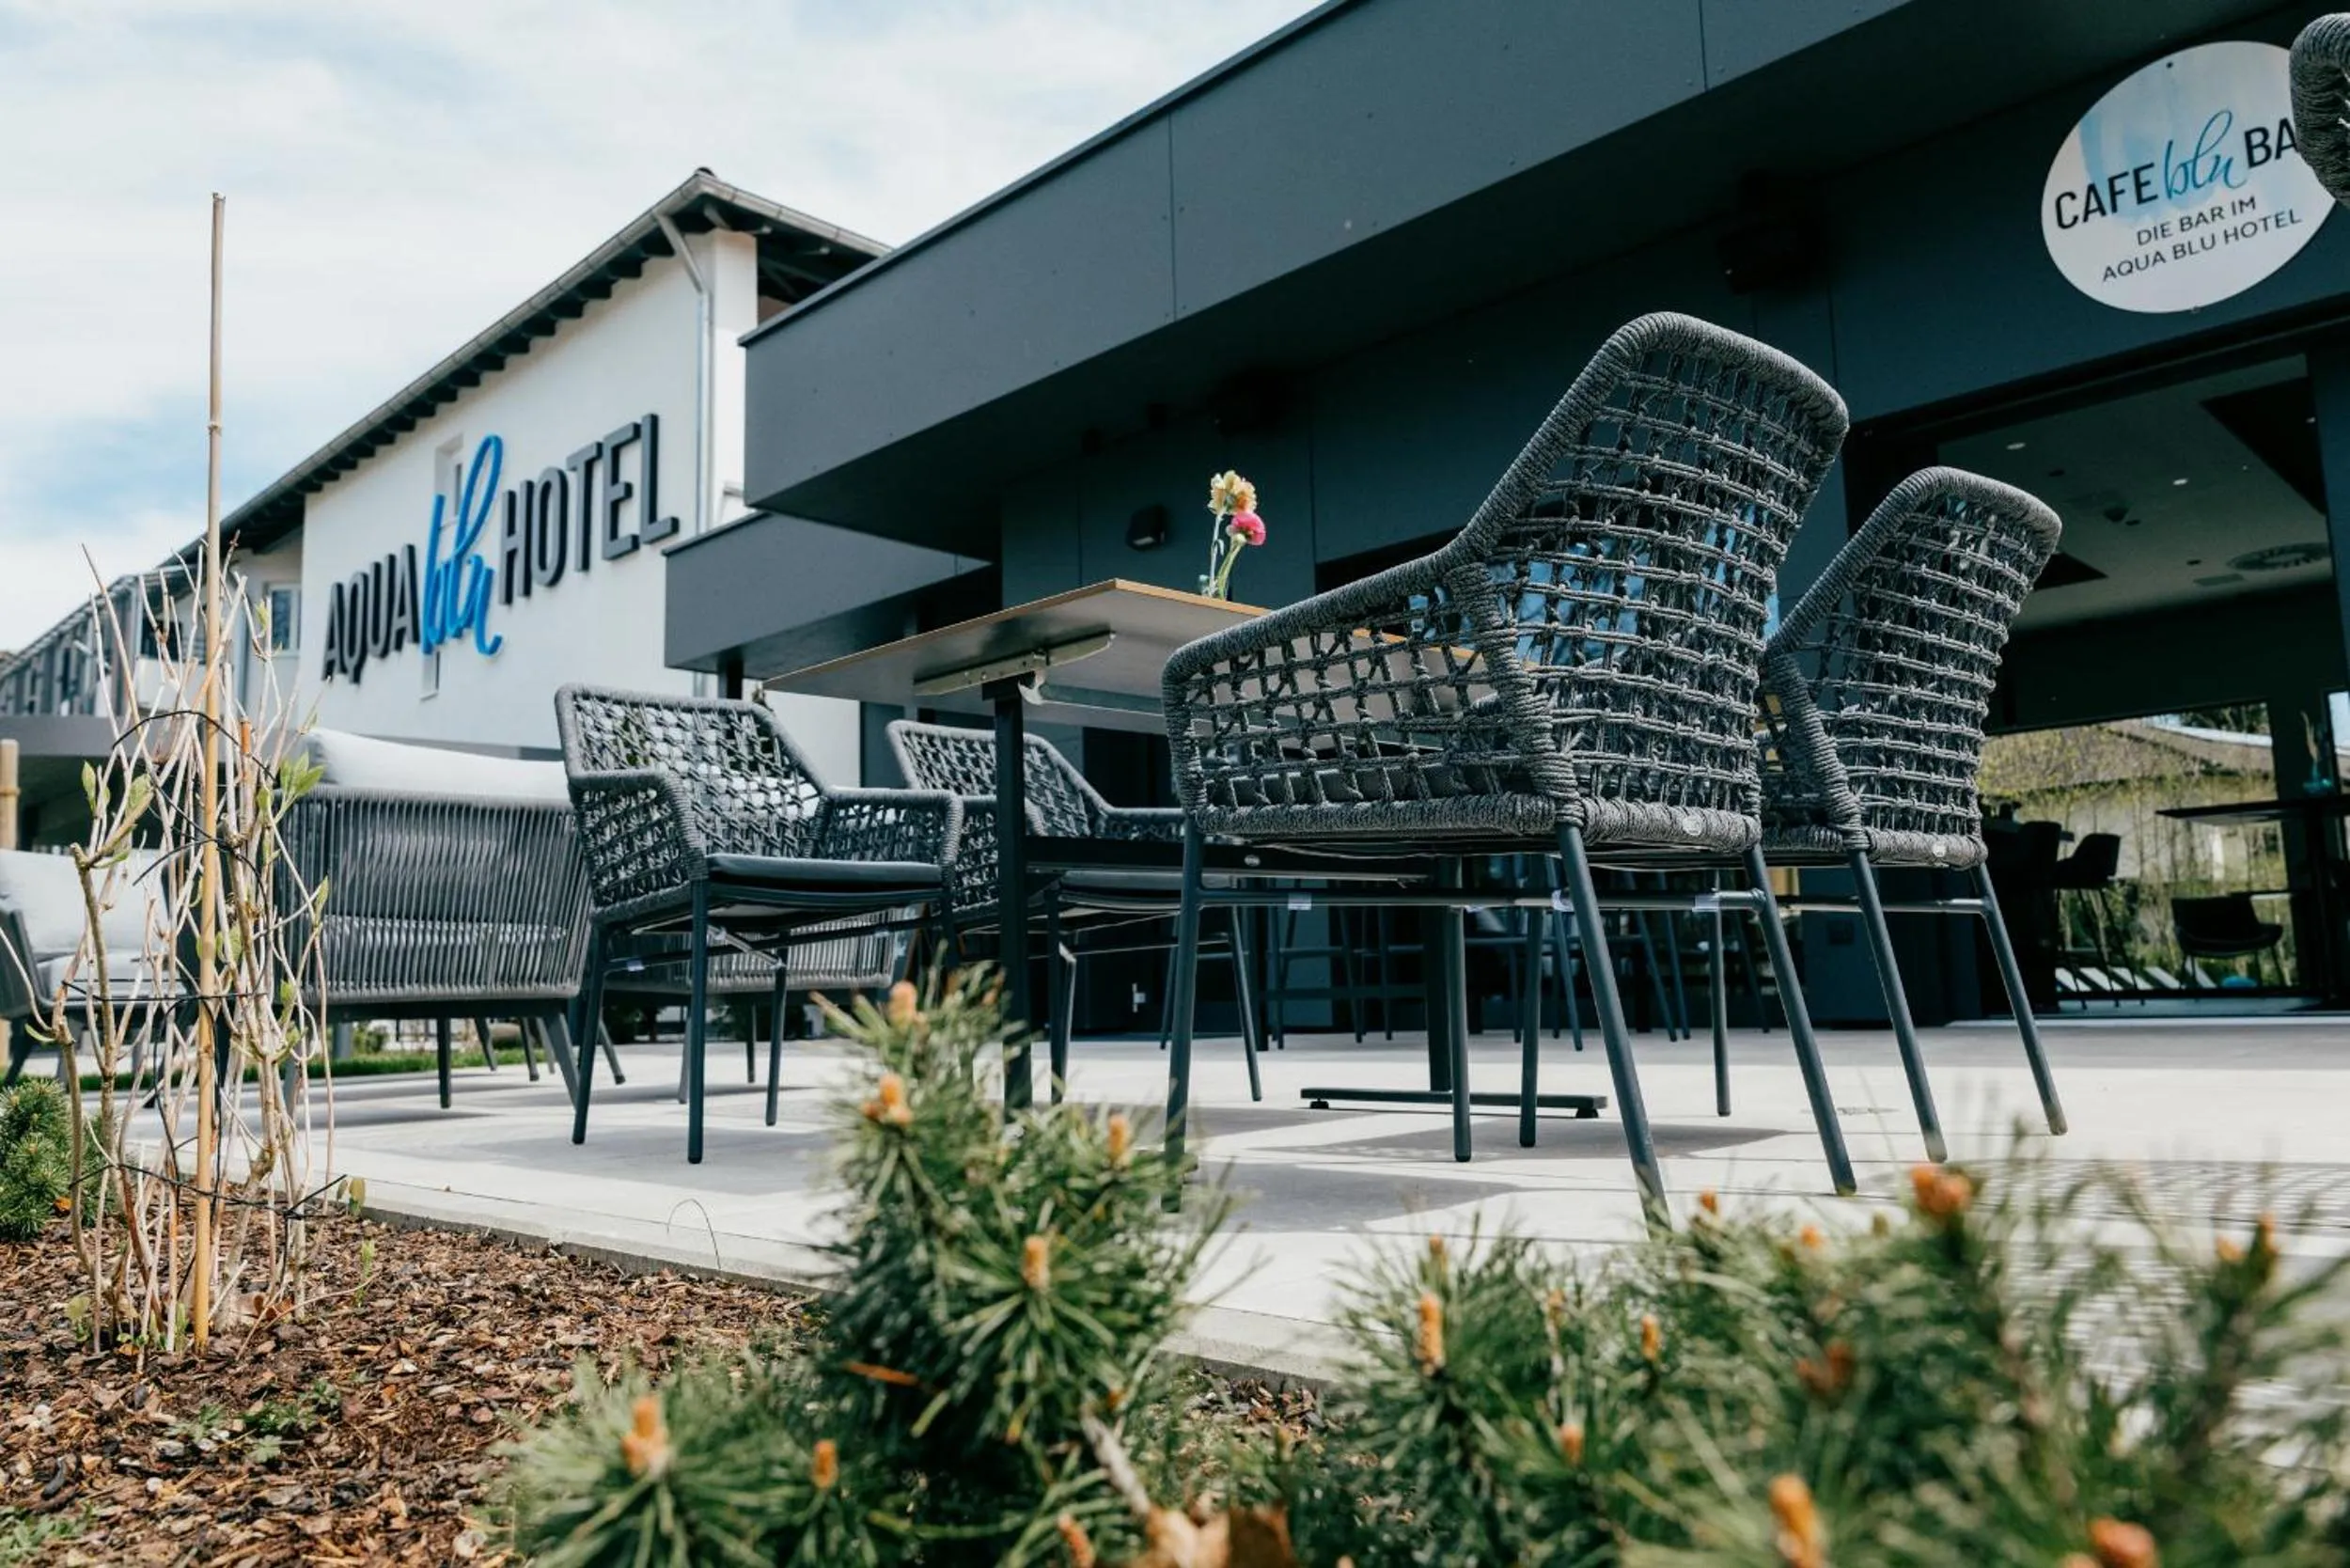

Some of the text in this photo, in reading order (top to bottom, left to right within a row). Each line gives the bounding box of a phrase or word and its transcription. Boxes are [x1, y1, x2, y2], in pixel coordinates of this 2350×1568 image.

[2055, 163, 2158, 230] CAFE
[2244, 118, 2299, 169] BA
[2102, 209, 2302, 282] AQUA BLU HOTEL
[2136, 196, 2257, 246] DIE BAR IM
[321, 543, 420, 684] AQUA
[498, 413, 680, 606] HOTEL
